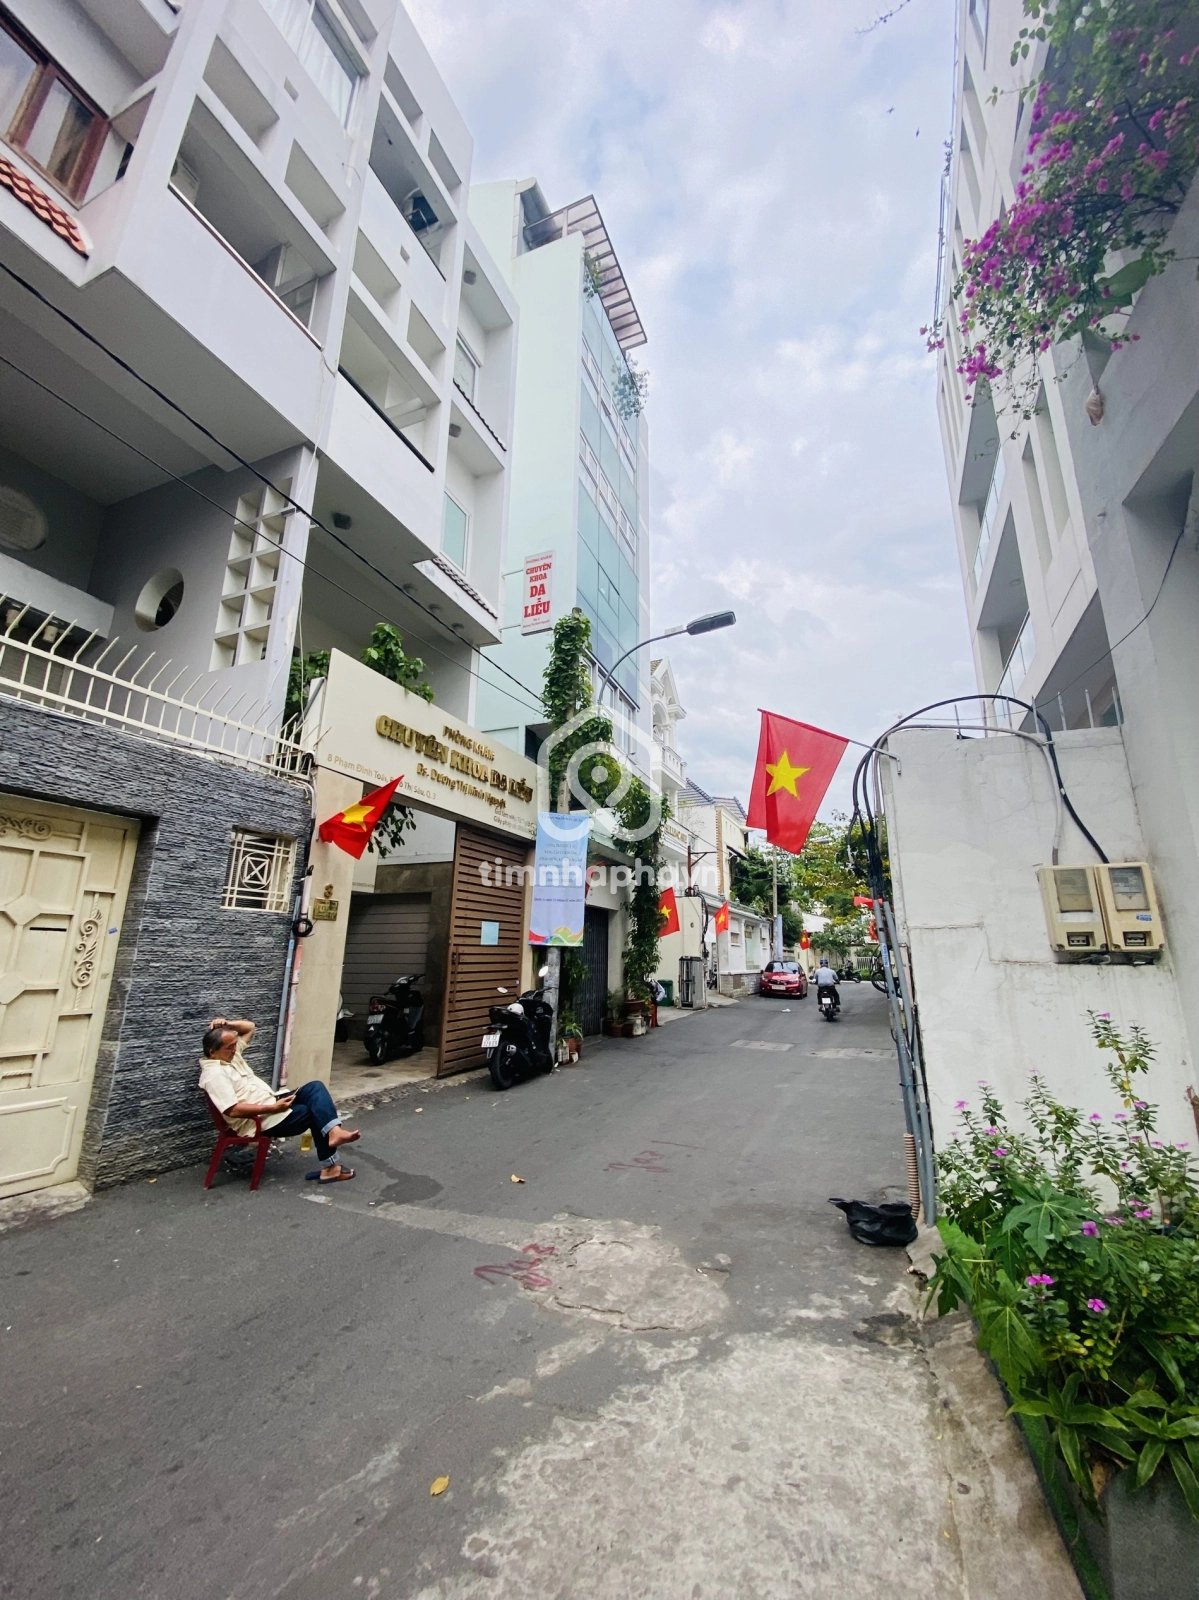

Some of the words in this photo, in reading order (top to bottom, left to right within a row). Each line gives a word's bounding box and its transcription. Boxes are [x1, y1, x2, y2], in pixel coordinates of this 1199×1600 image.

[526, 563, 552, 575] CHUYÊN
[529, 573, 547, 583] KHOA
[530, 584, 546, 598] DA
[524, 598, 551, 618] LIỄU
[442, 725, 473, 750] PHÒNG
[376, 714, 450, 764] CHUYÊN
[450, 749, 489, 783] KHOA
[490, 768, 508, 792] DA
[327, 754, 333, 762] 8
[334, 756, 355, 772] Phạm
[356, 764, 373, 778] Đình
[404, 781, 413, 790] Thị
[432, 792, 437, 800] 3
[430, 768, 456, 790] Dương
[456, 779, 468, 797] Thị
[467, 782, 485, 800] Minh
